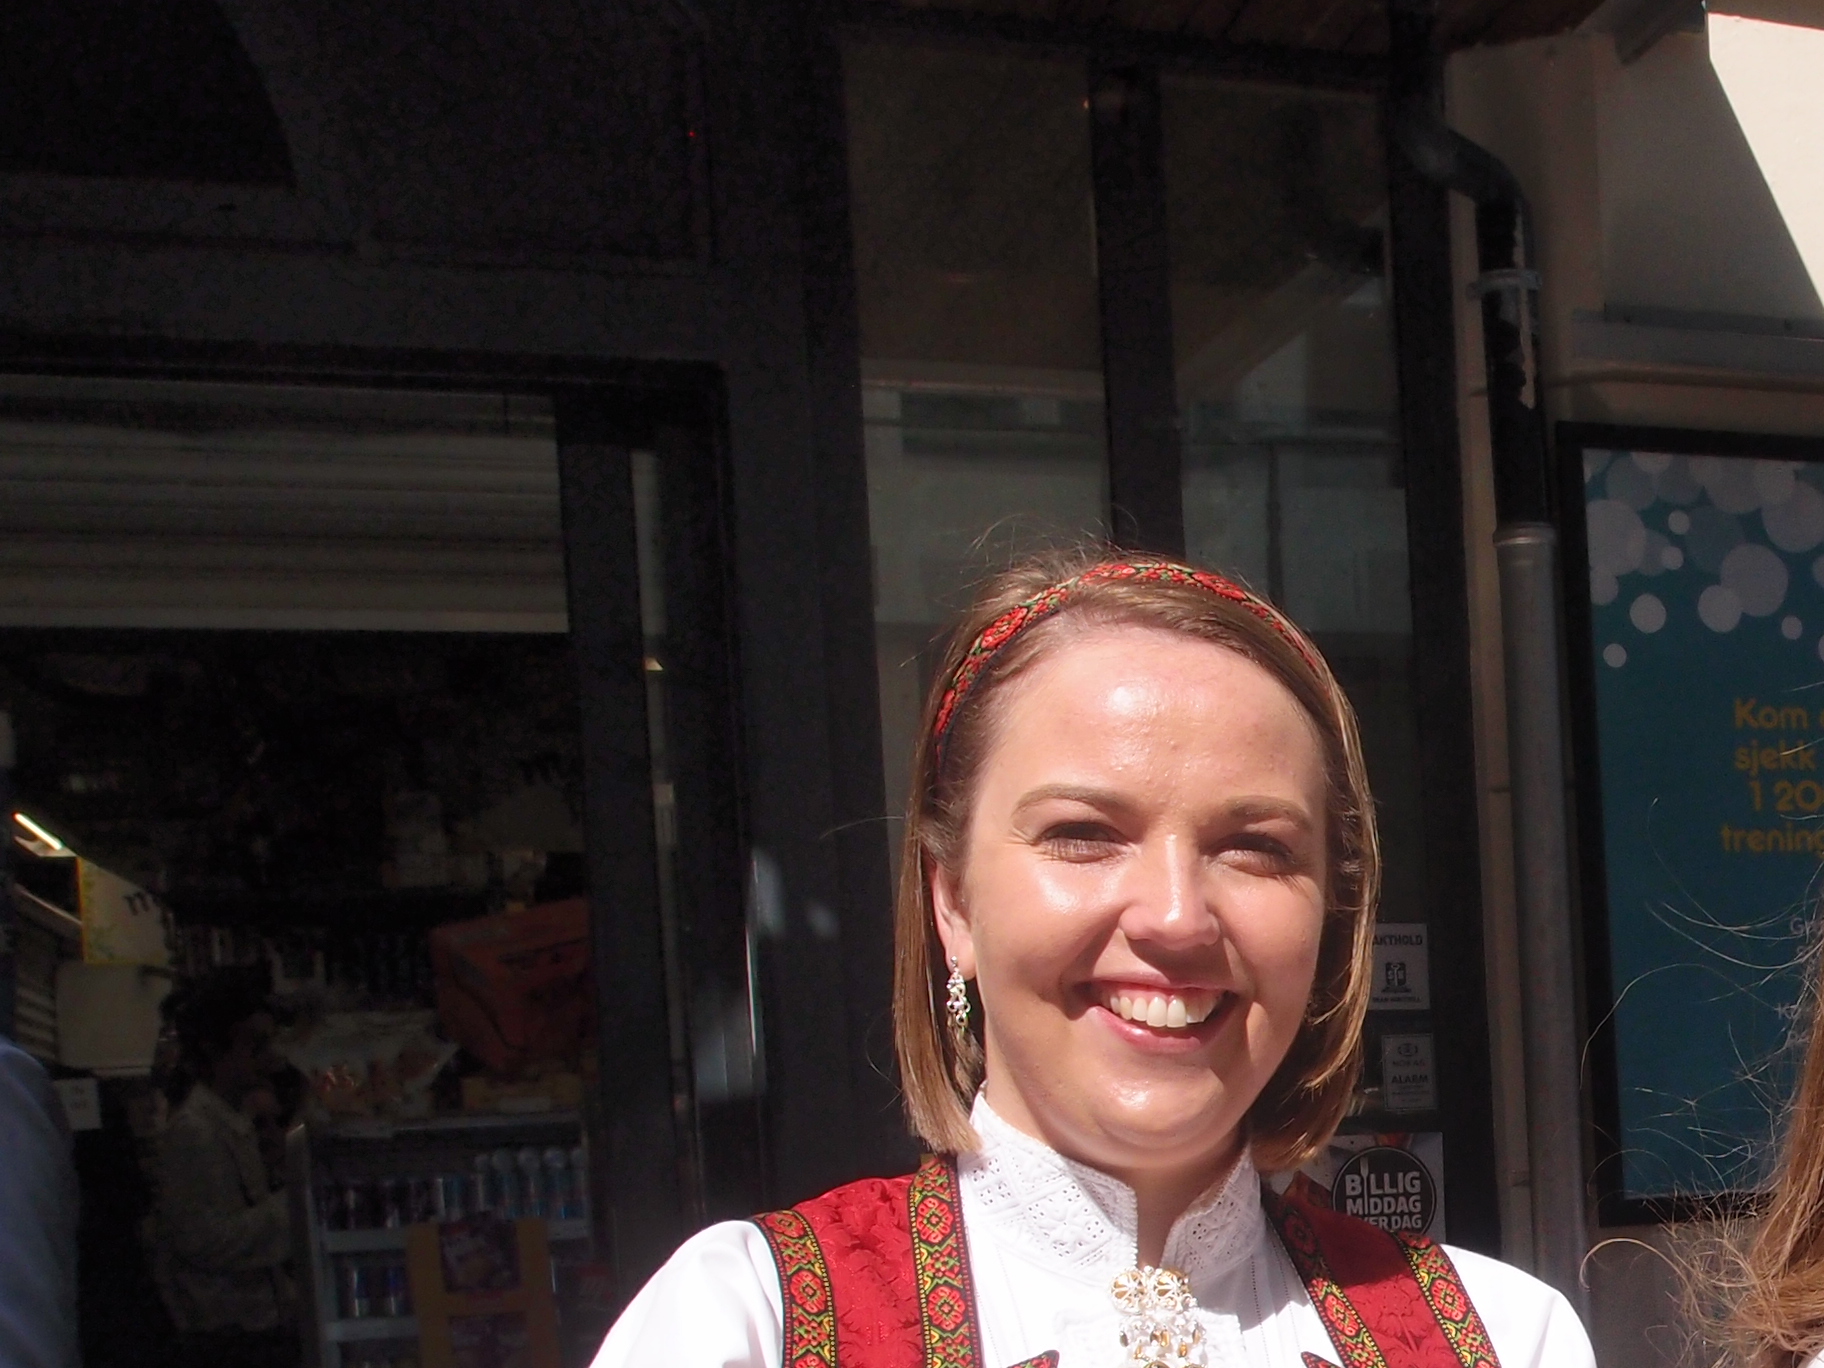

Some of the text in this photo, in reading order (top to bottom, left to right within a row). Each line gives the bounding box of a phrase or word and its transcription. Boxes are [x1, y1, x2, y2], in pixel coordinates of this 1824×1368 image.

[1734, 697, 1809, 729] Kom
[1735, 738, 1817, 776] sjekk
[1749, 780, 1763, 811] 1
[1345, 1171, 1421, 1196] BILLIG
[1345, 1194, 1422, 1216] MIDDAG
[1391, 1214, 1423, 1230] DAG
